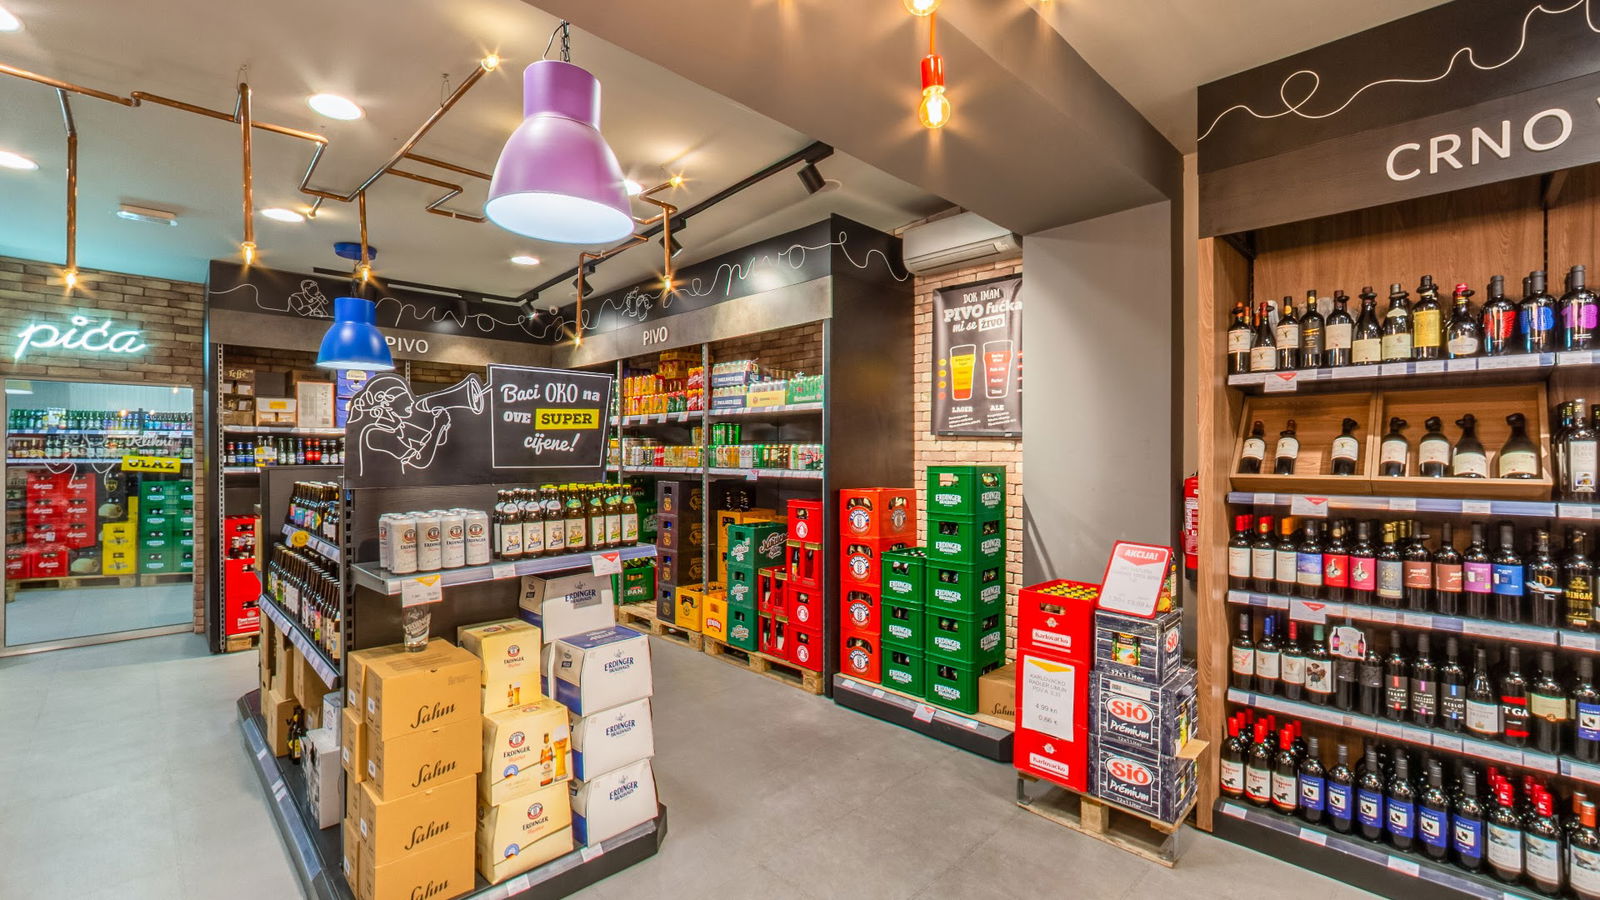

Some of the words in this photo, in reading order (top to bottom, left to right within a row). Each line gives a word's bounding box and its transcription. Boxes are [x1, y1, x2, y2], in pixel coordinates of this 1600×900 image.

[1386, 108, 1573, 181] CRNO
[963, 293, 978, 304] DOK
[980, 288, 1001, 301] IMAM
[944, 304, 984, 323] PIVO
[643, 327, 668, 345] PIVO
[952, 322, 965, 333] mi
[966, 321, 978, 331] se
[15, 316, 147, 359] pića
[385, 336, 428, 354] PIVO
[501, 384, 541, 403] Baci
[545, 383, 578, 403] OKO
[583, 390, 600, 402] na
[990, 404, 1004, 412] ALE
[503, 411, 531, 424] OVE
[541, 413, 592, 425] SUPER
[524, 433, 580, 455] cijene!
[128, 460, 175, 470] ULAZ
[565, 589, 597, 602] ERDINGER
[504, 657, 524, 665] ERDINGER
[604, 657, 634, 672] ERDINGER
[410, 701, 457, 729] Sahm
[1112, 700, 1148, 721] Sió
[605, 720, 636, 737] ERDINGER
[1110, 720, 1150, 740] Prémium
[503, 746, 530, 758] ERDINGER
[411, 760, 457, 788] Sahm
[1112, 762, 1148, 784] Sió
[609, 780, 638, 801] ERDINGER
[1110, 780, 1150, 802] Prémium
[522, 816, 549, 830] ERDINGER
[404, 820, 450, 851] Sahm
